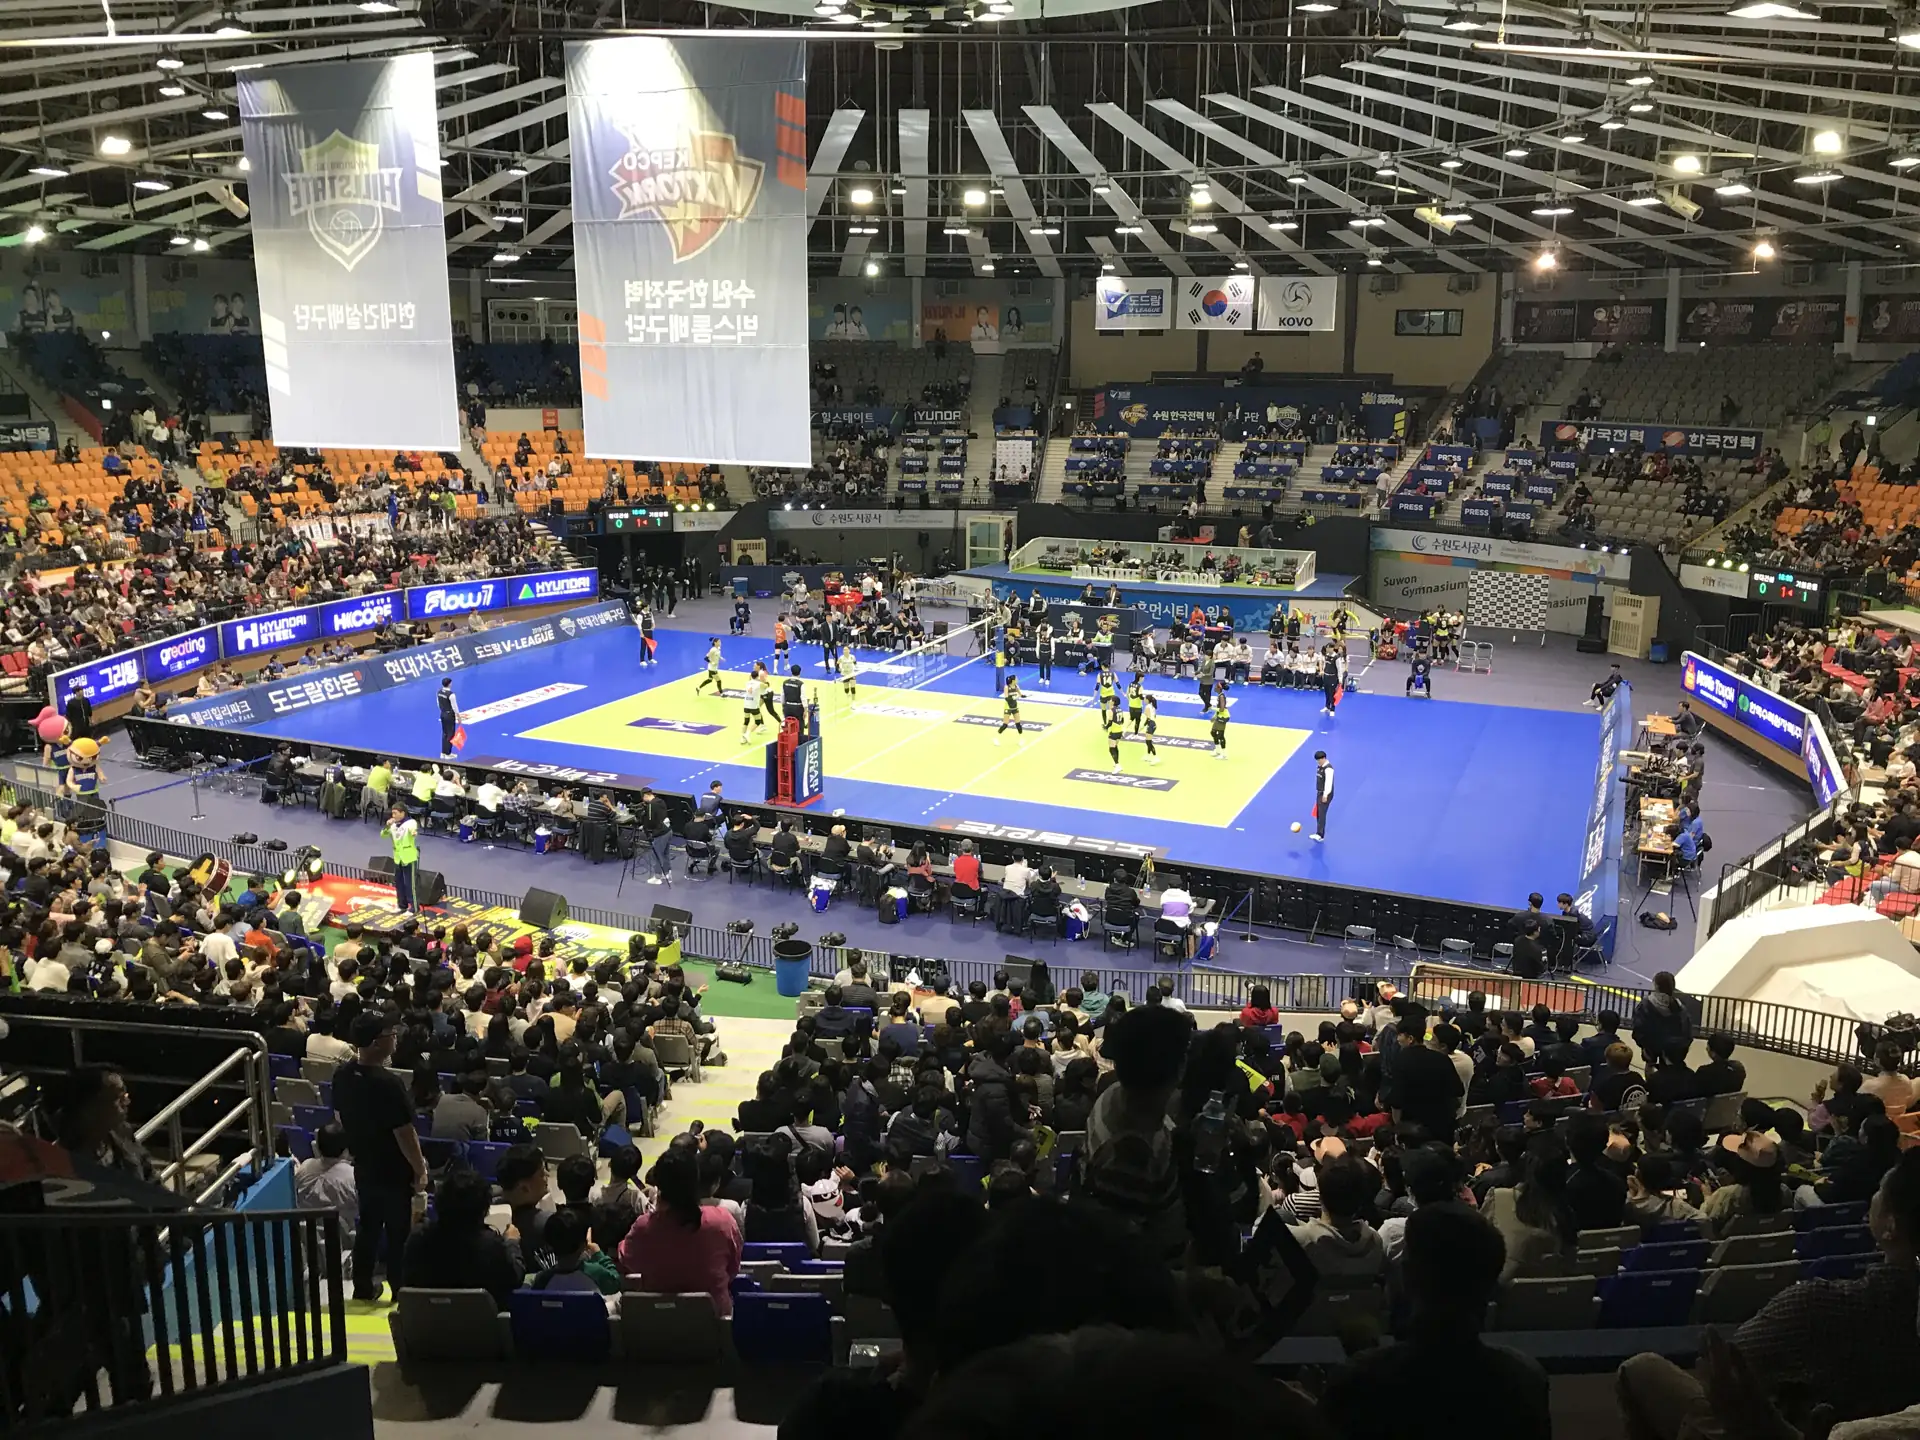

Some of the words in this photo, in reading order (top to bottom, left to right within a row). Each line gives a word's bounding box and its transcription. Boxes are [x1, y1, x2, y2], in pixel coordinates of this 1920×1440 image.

[1278, 317, 1313, 327] KOVO
[821, 411, 874, 423] 힐스테이트
[914, 410, 961, 421] YUNDA
[1152, 410, 1169, 421] 수원
[1170, 411, 1204, 421] 한국전력
[1688, 432, 1756, 450] 한국전력
[1550, 460, 1576, 469] PRESS
[1486, 482, 1511, 491] PRESS
[1528, 485, 1554, 494] PRESS
[1399, 502, 1424, 511] PRESS
[1464, 508, 1489, 516] PRESS
[829, 512, 882, 524] 수원도시공사
[1505, 511, 1531, 520] PRESS
[615, 519, 623, 528] 0
[636, 518, 641, 527] 1
[656, 518, 661, 527] 1
[1432, 537, 1493, 556] 수원도시공사
[535, 576, 590, 593] HYUNDAI
[1383, 574, 1418, 588] Suwon
[1401, 579, 1469, 598] Gymnasium
[1759, 583, 1767, 594] 0
[1780, 586, 1786, 598] 1
[1802, 591, 1807, 602] 1
[259, 614, 307, 634] HYUNDAI
[576, 607, 626, 630] 현대건설배구단
[261, 629, 296, 645] STEEL
[474, 642, 501, 659] 도드람
[501, 629, 555, 653] V-LEAGUE
[160, 636, 206, 666] greating
[383, 644, 465, 683] 현대차증권
[98, 658, 139, 693] 그리팅
[1102, 676, 1112, 685] 14
[267, 670, 362, 714] 도드람한돈
[190, 700, 252, 725] 웰리힐리파크
[1075, 771, 1138, 784] asics
